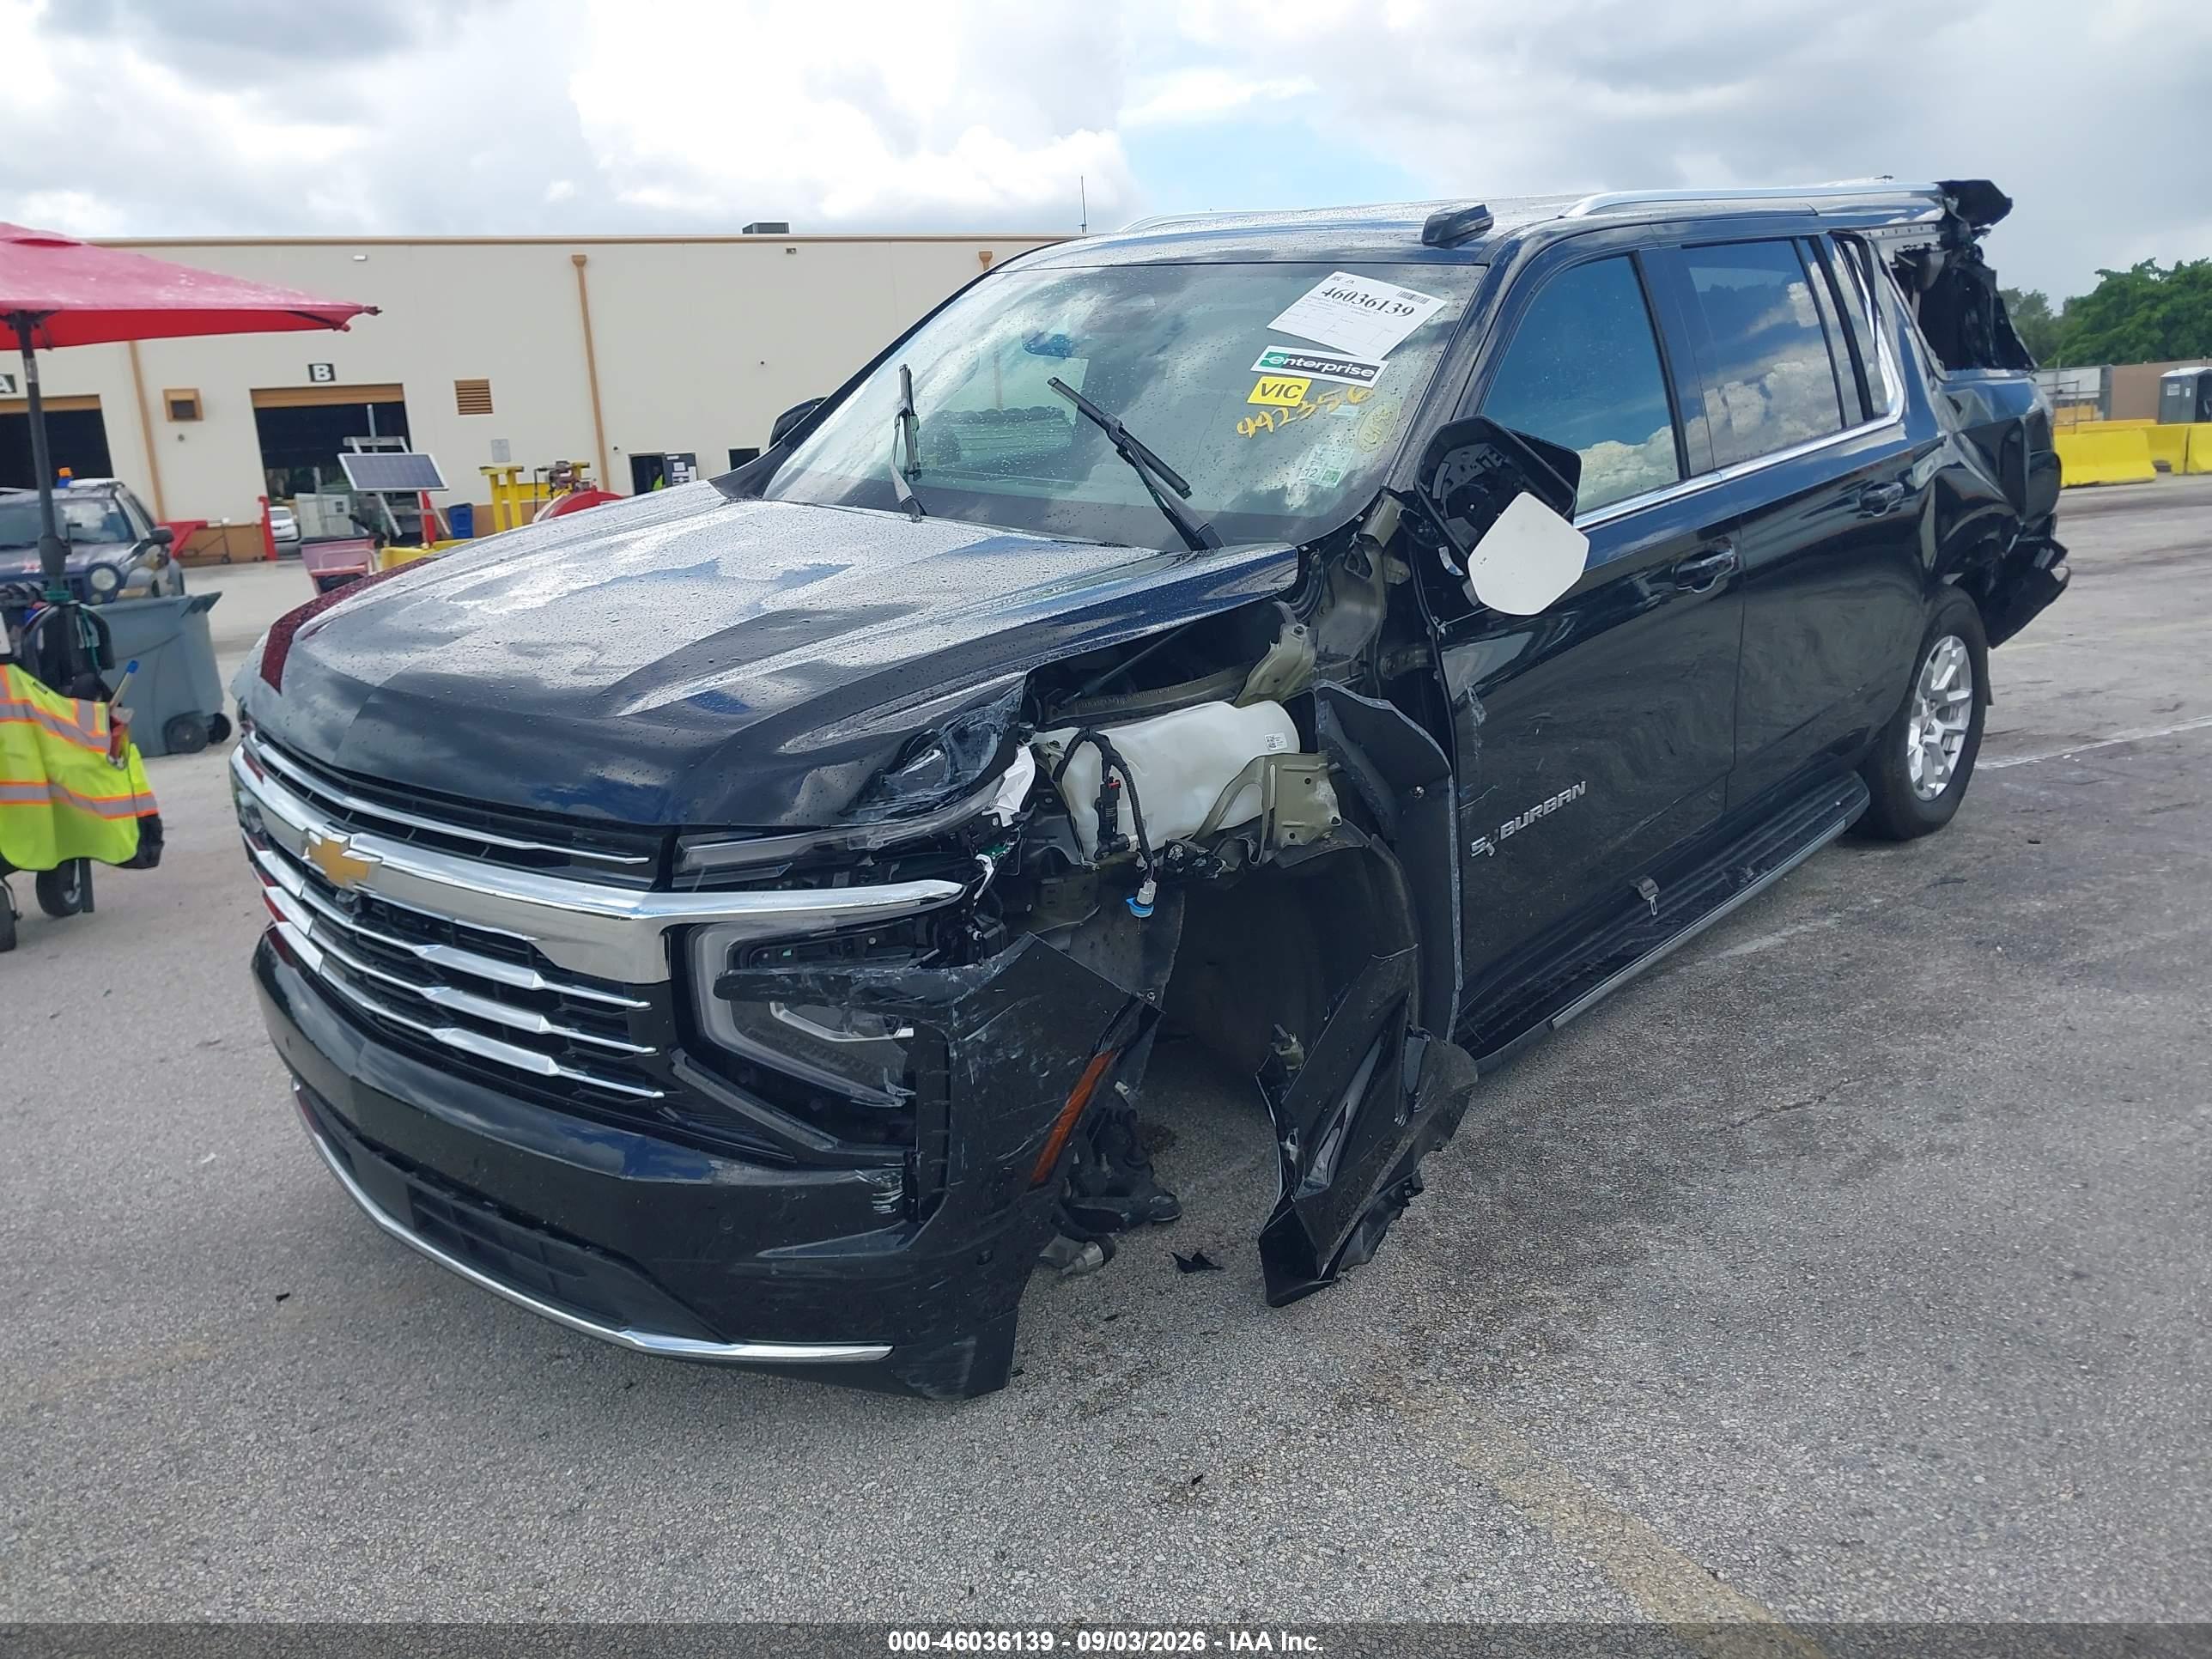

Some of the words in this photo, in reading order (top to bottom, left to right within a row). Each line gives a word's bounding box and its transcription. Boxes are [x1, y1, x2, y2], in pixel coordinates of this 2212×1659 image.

[1321, 287, 1415, 317] 46036139
[313, 365, 331, 380] B
[1267, 355, 1376, 378] enterprise
[1261, 383, 1303, 399] VIC
